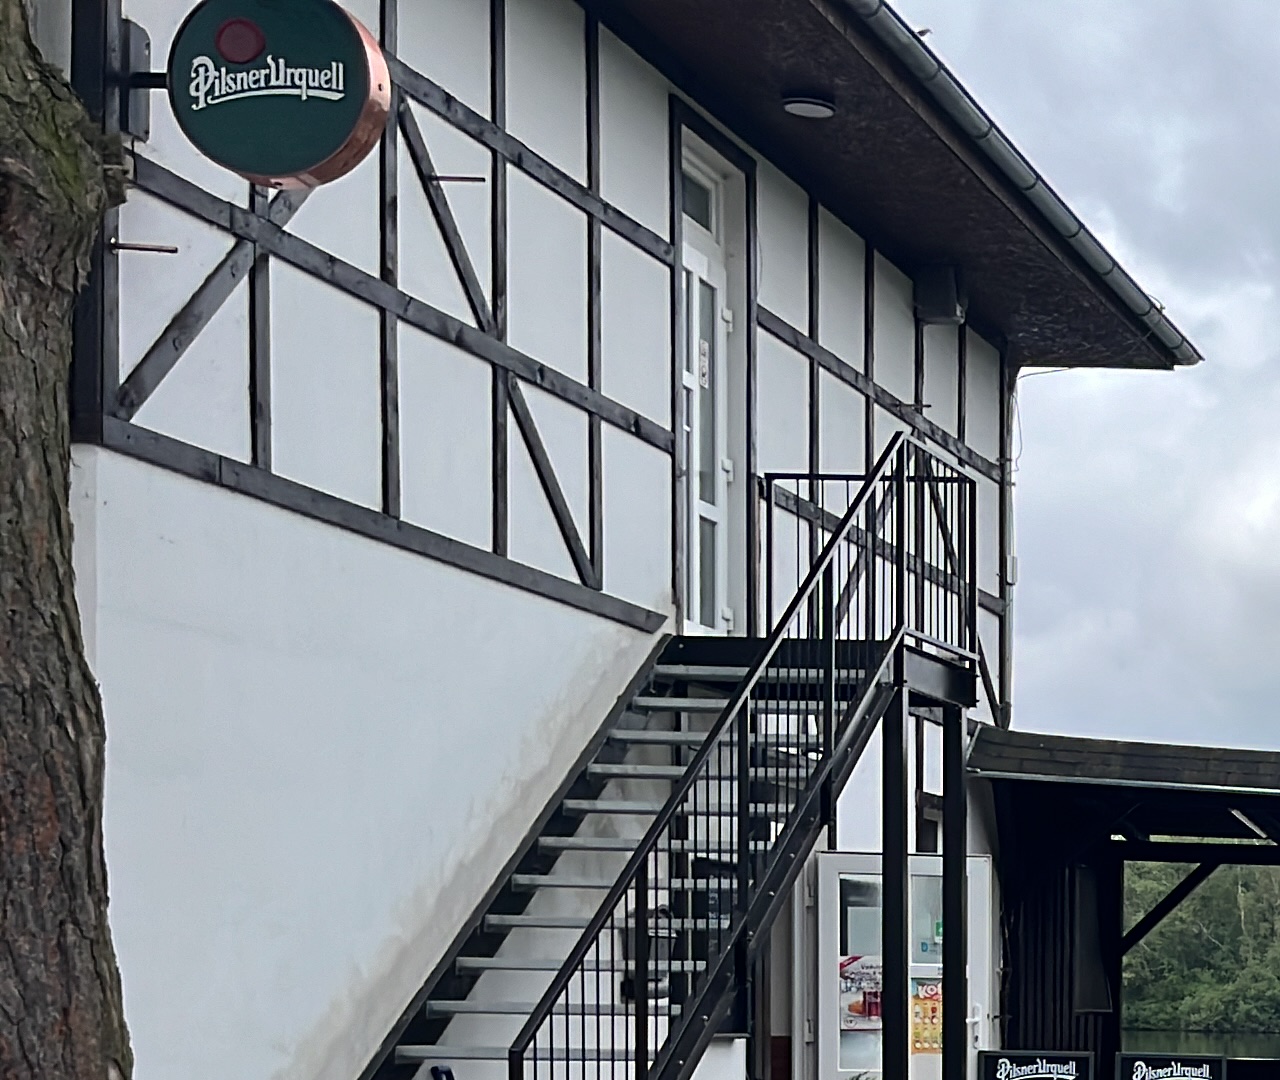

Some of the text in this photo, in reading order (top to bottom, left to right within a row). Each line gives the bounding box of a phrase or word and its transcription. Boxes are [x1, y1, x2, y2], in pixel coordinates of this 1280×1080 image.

[189, 54, 344, 110] Pilsner Urquell
[1037, 1057, 1076, 1080] Urquell
